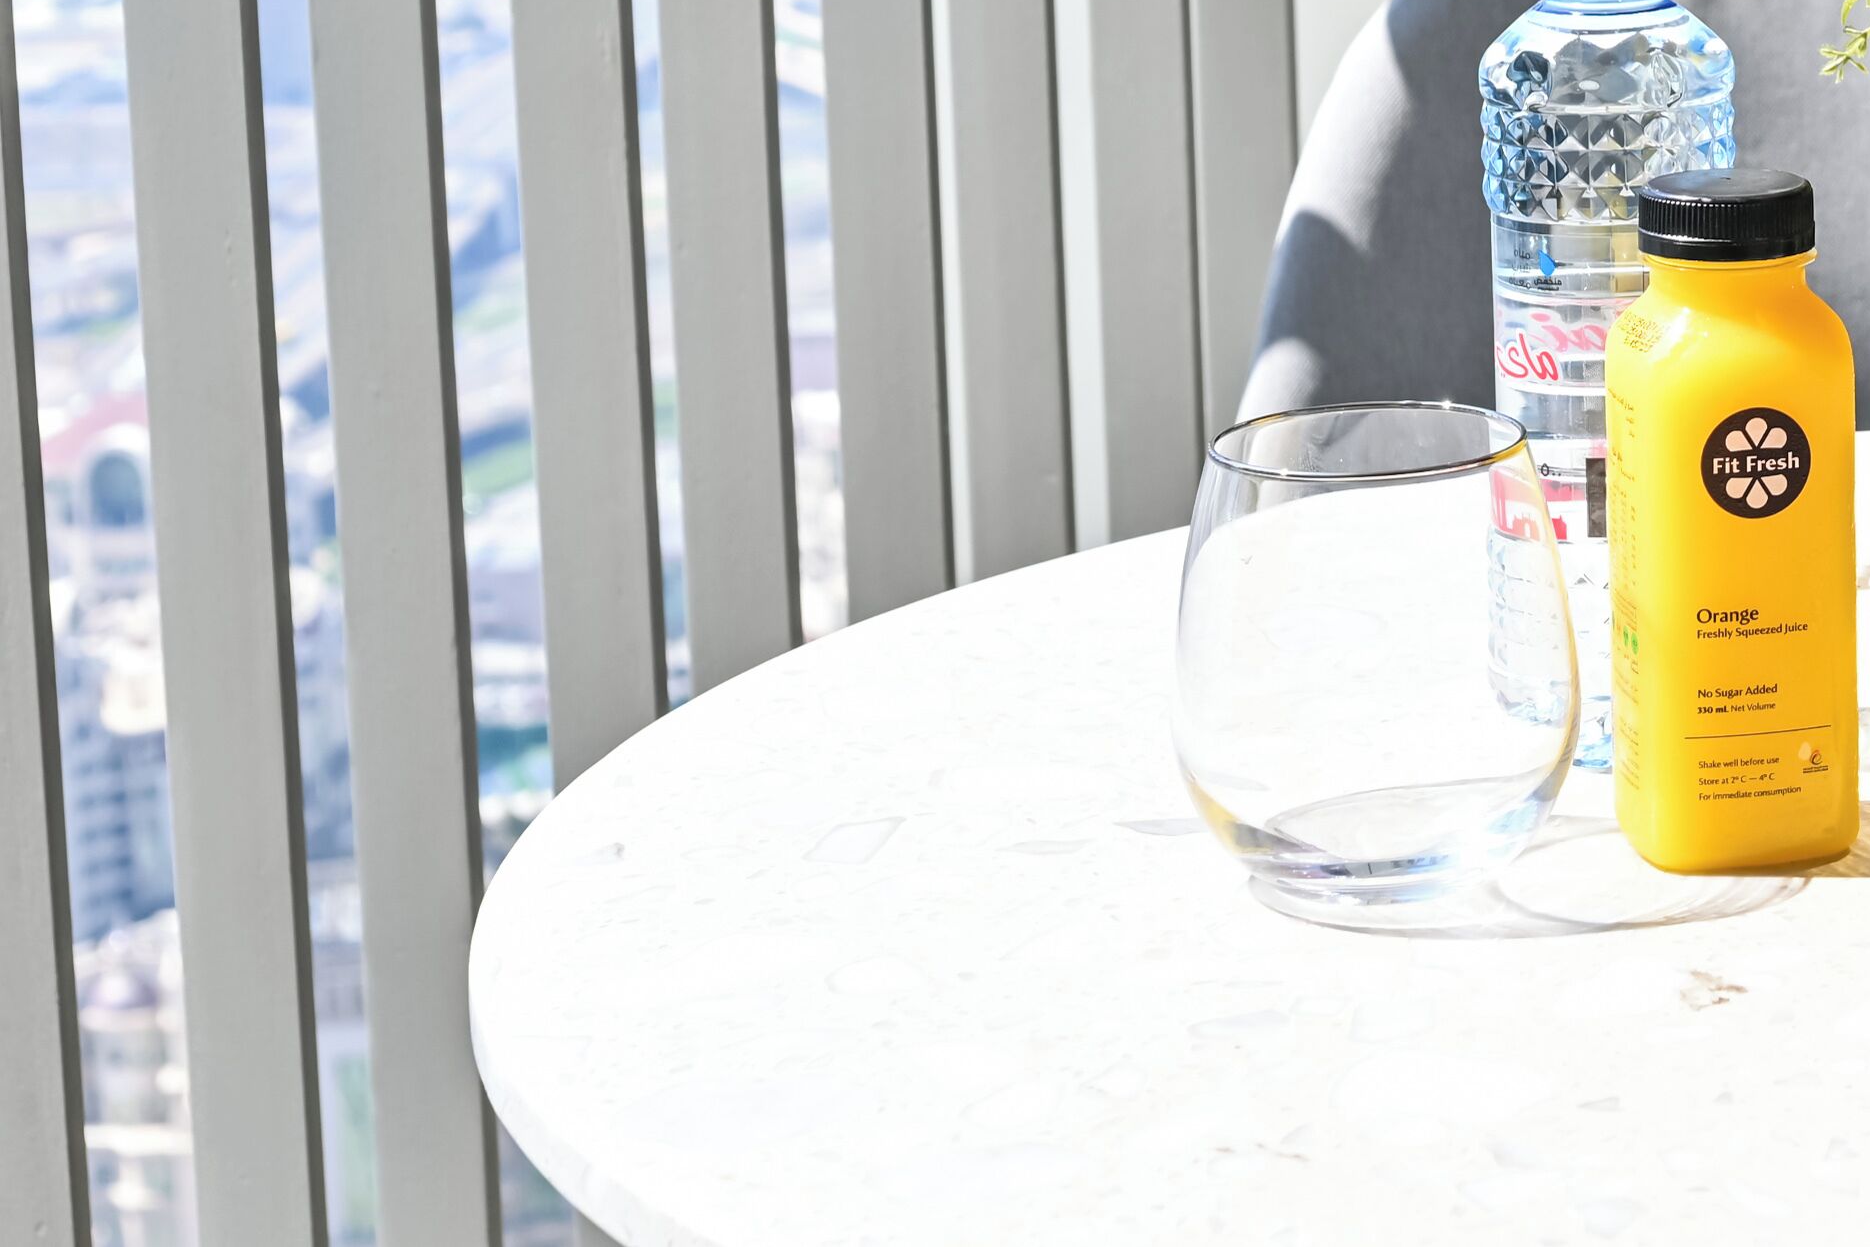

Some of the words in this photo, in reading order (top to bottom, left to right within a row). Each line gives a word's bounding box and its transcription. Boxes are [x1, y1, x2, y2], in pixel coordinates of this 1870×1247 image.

[1712, 456, 1740, 475] Fit
[1746, 451, 1800, 473] Fresh
[1696, 608, 1760, 626] Orange
[1696, 627, 1734, 640] Freshly
[1735, 623, 1783, 639] Squeezed
[1783, 621, 1809, 635] Juice
[1697, 689, 1713, 699] No
[1714, 687, 1744, 700] Sugar
[1744, 683, 1779, 696] Added
[1697, 706, 1714, 715] 330
[1730, 703, 1746, 713] Net
[1746, 701, 1777, 712] Volume
[1698, 759, 1722, 769] Shake
[1722, 758, 1739, 767] well
[1740, 756, 1765, 767] before
[1766, 756, 1780, 765] use
[1698, 776, 1720, 786] Store
[1721, 776, 1729, 785] at
[1740, 774, 1747, 784] C
[1768, 772, 1776, 781] C
[1698, 791, 1712, 801] For
[1712, 789, 1752, 800] immediate
[1753, 784, 1802, 798] consumption
